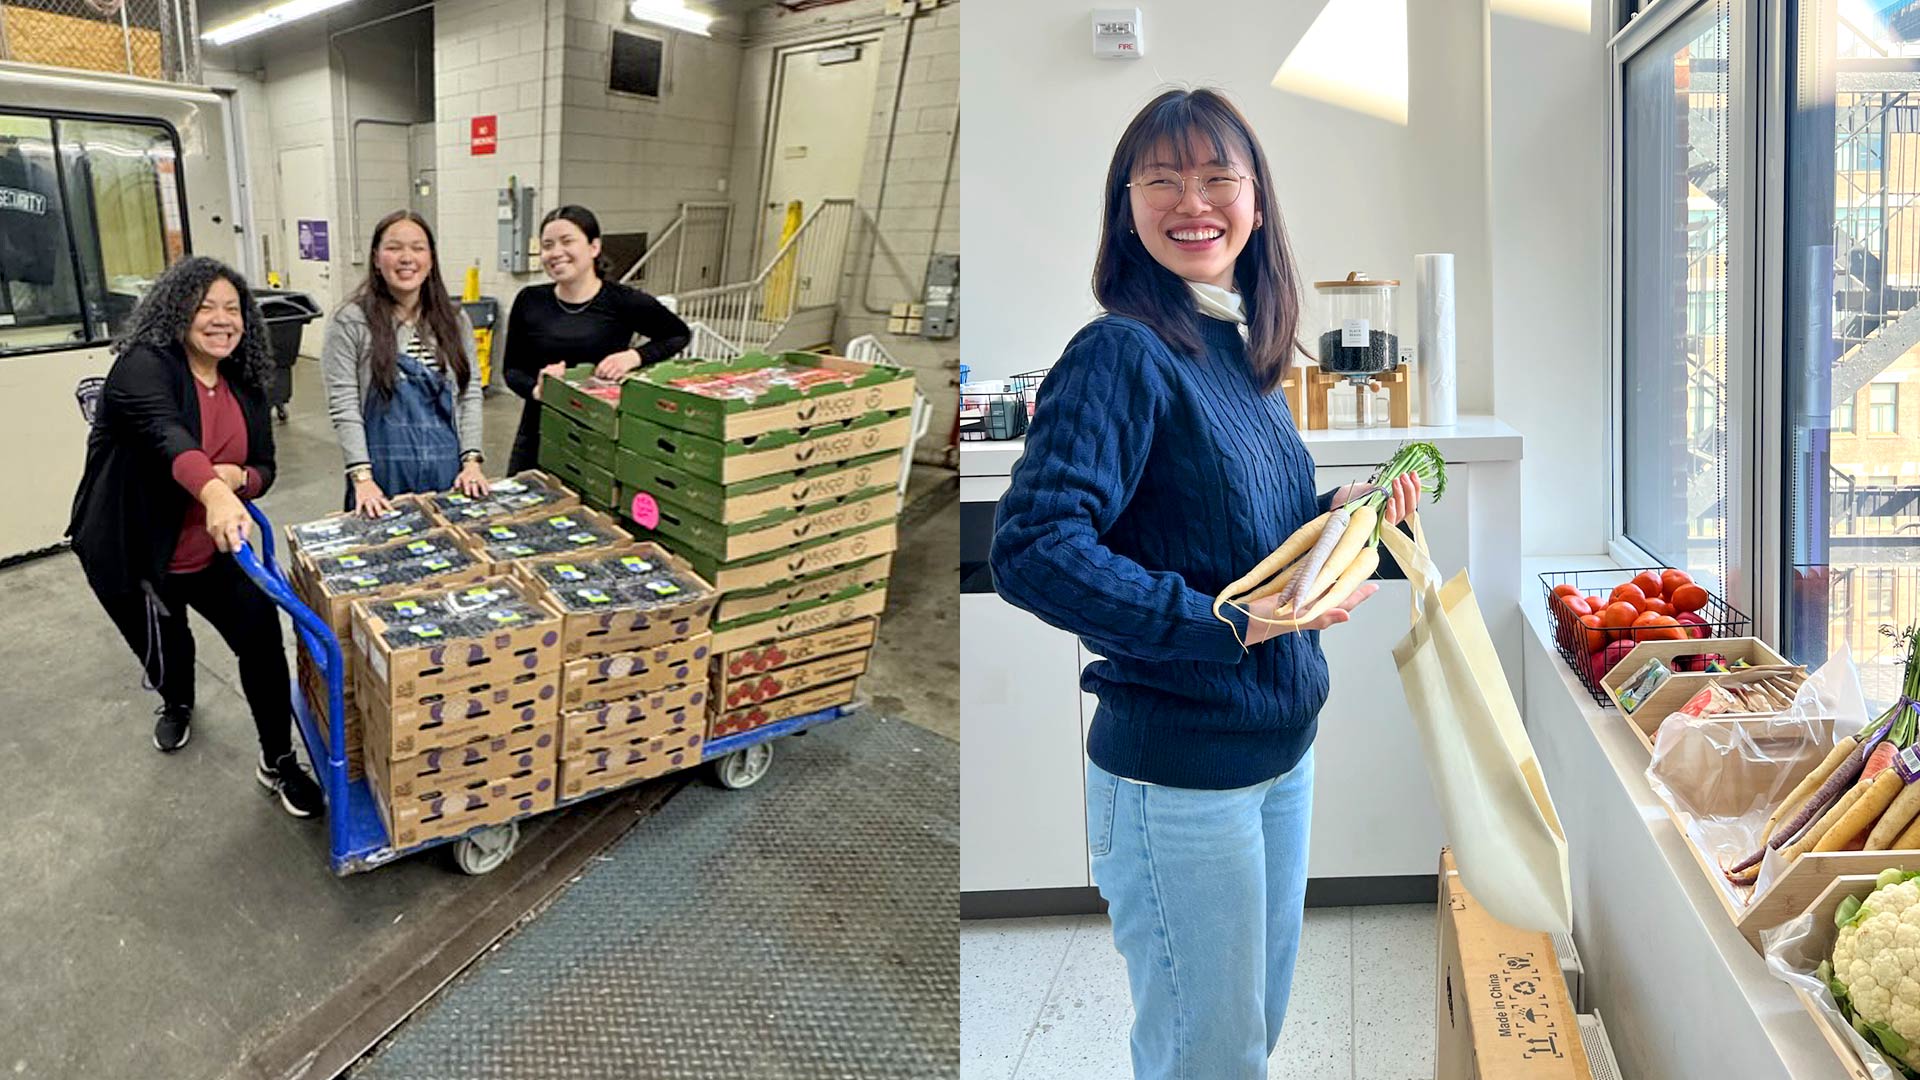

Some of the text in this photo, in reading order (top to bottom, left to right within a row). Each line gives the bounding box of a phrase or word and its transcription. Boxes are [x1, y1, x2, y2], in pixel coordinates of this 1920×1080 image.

[1488, 974, 1511, 1036] Made in China
